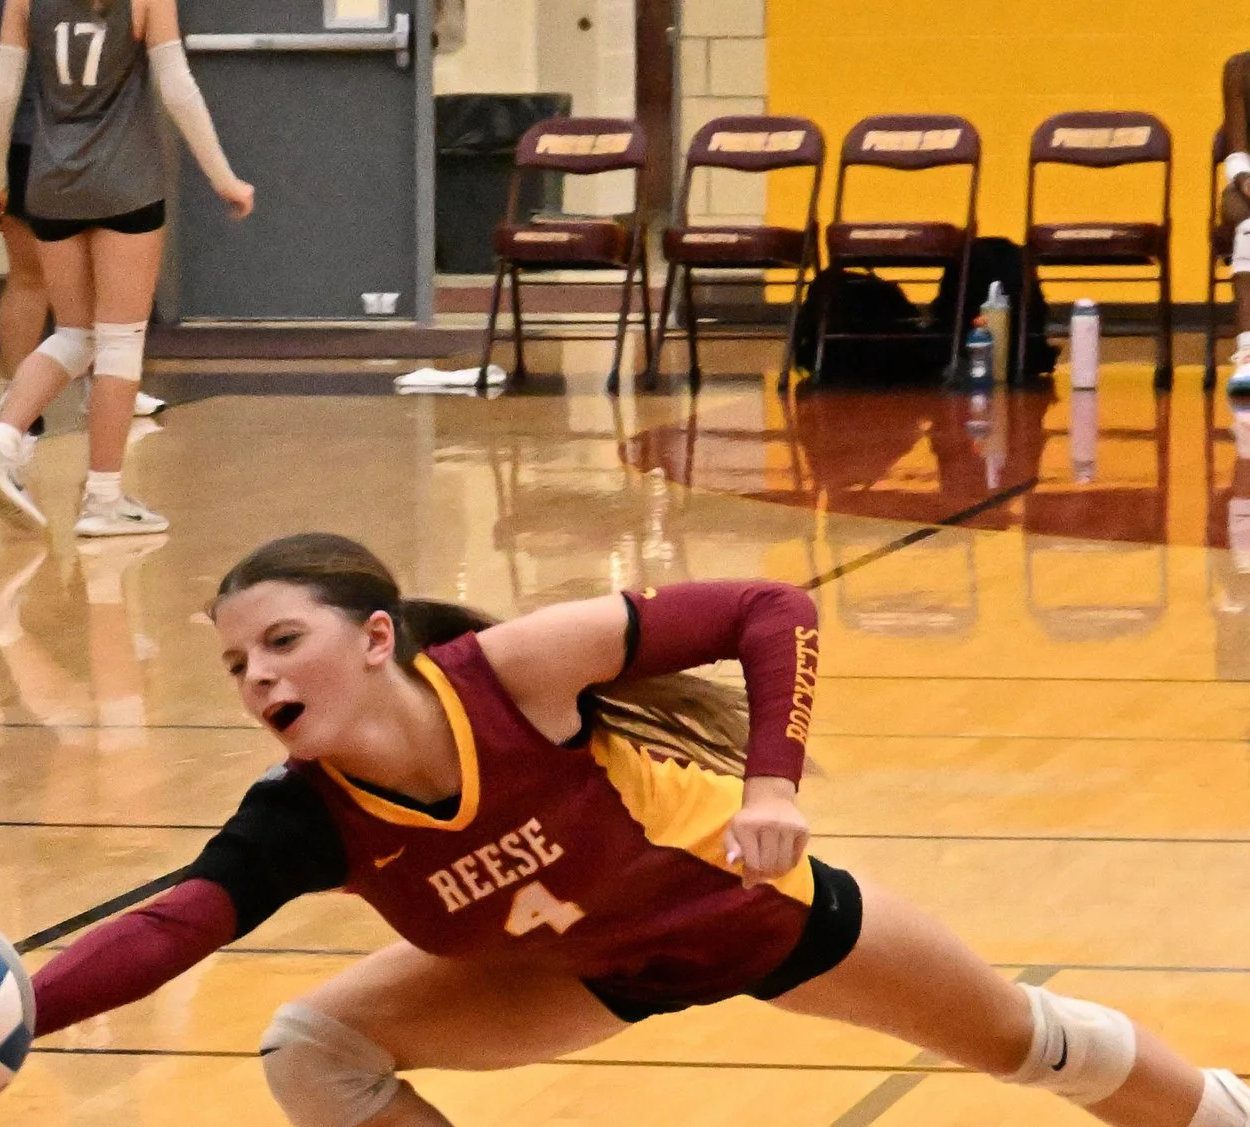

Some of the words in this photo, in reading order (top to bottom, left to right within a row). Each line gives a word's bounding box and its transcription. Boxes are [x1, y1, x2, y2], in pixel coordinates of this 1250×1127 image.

[54, 21, 108, 87] 17
[785, 625, 819, 745] ROCKETS
[428, 817, 564, 913] REESE
[503, 879, 586, 937] 4
